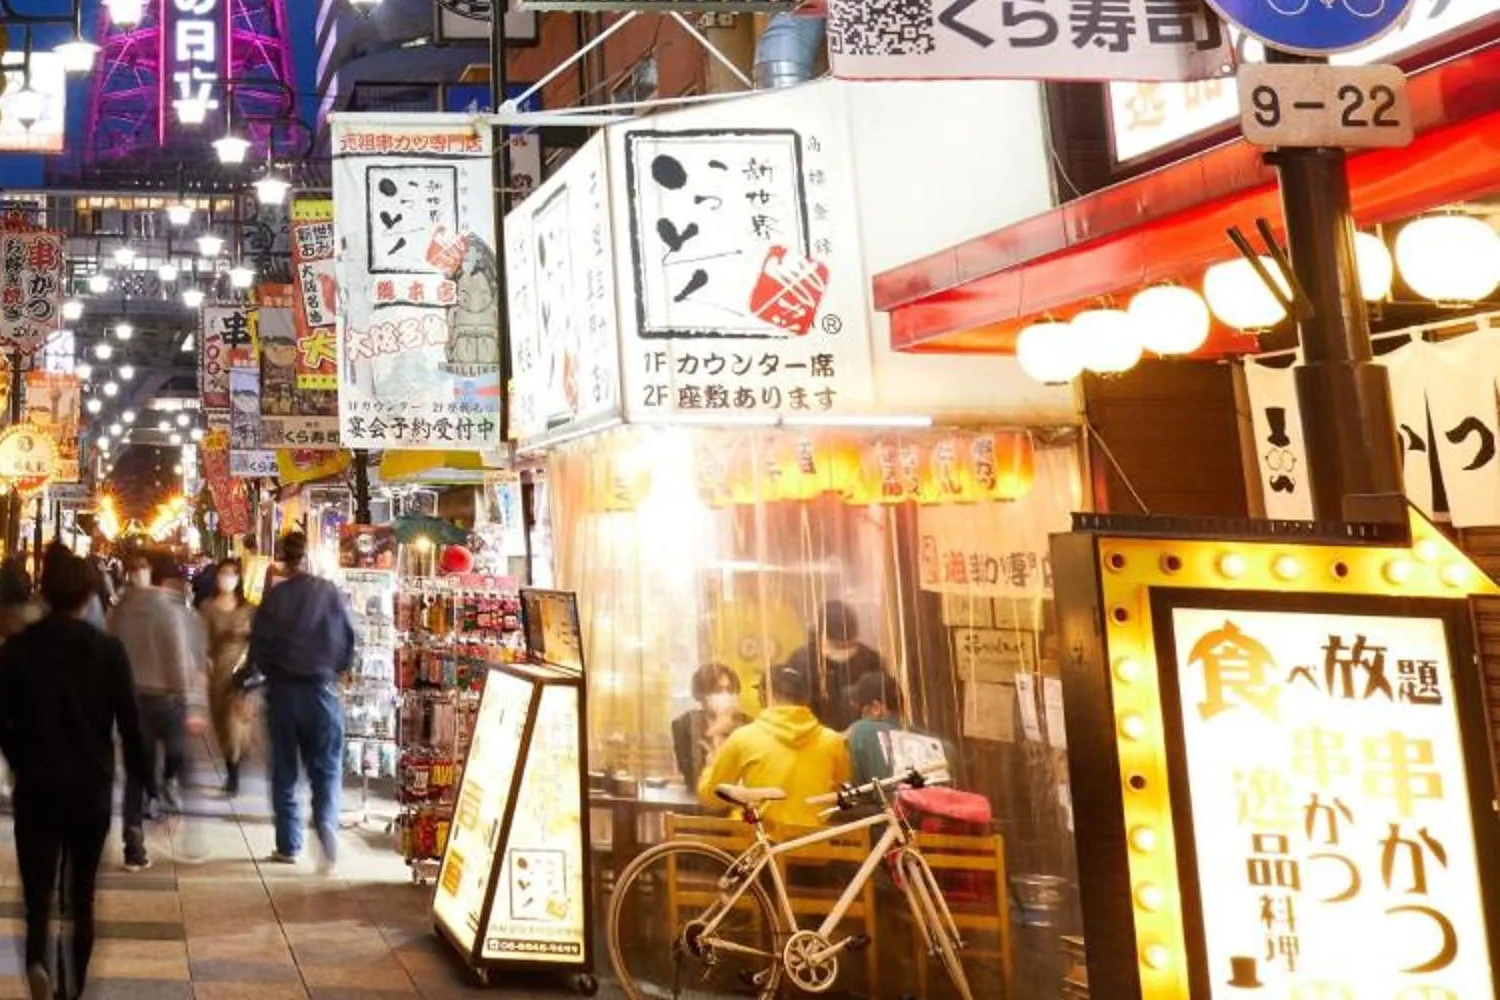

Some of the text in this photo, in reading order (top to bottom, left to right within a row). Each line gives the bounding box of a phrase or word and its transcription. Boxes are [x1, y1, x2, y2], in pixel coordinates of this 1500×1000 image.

[642, 384, 838, 411] 2F 座敷あります
[643, 352, 836, 378] 1F カウンター席
[347, 415, 495, 441] 宴会予約受付中
[1187, 619, 1443, 724] 食べ放題
[1289, 724, 1363, 904] 串かつ
[1361, 728, 1460, 975] 串かつ
